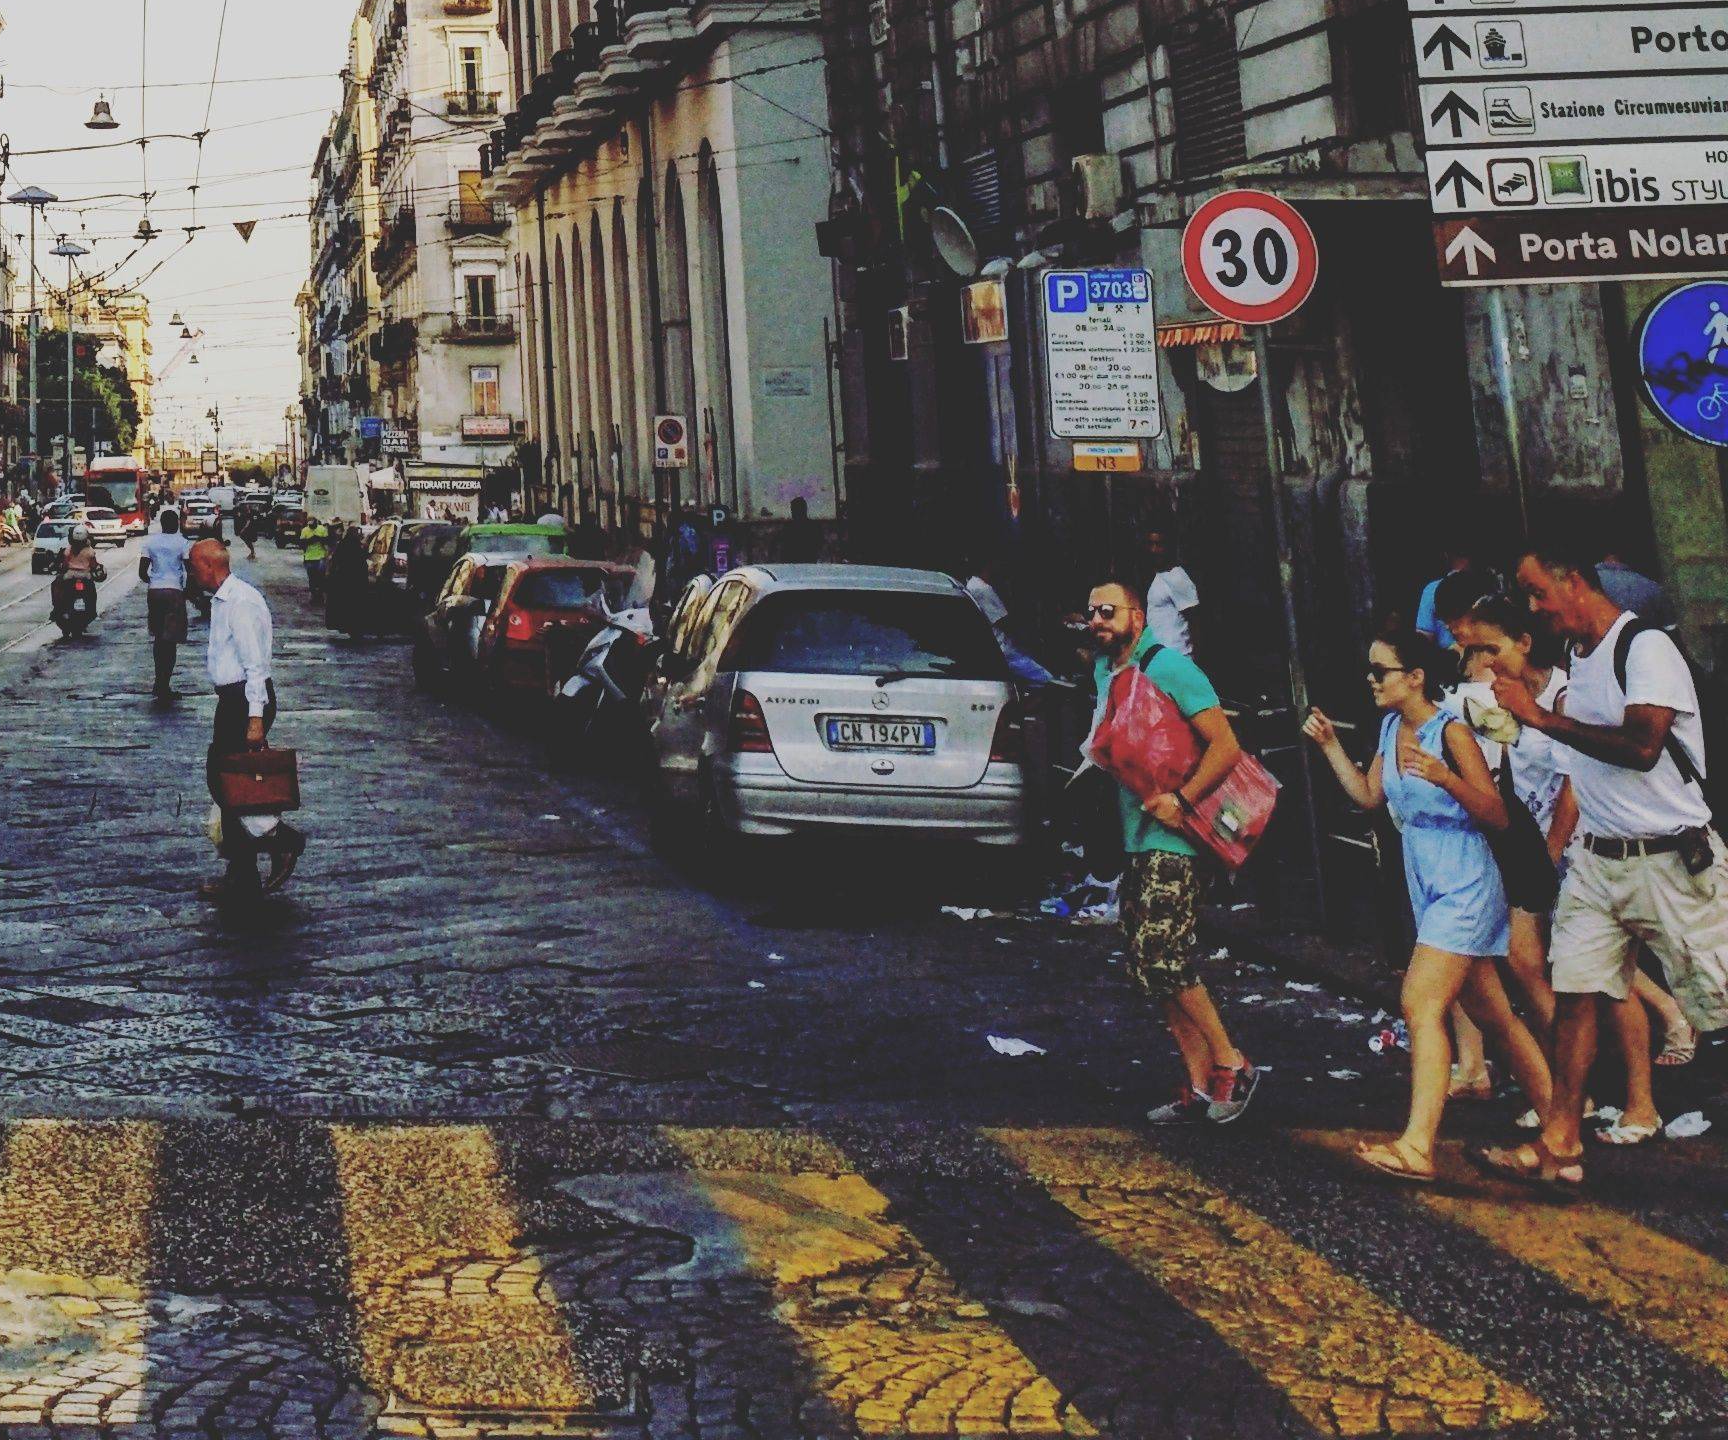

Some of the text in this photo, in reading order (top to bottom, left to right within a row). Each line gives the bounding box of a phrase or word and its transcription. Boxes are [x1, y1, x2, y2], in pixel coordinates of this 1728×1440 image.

[1631, 25, 1728, 54] Porto
[1540, 99, 1605, 118] Stazione
[1595, 168, 1660, 203] ibis
[1212, 227, 1288, 288] 30
[1520, 232, 1618, 262] Porta
[1057, 280, 1079, 308] P
[409, 480, 482, 490] RISTORANTE PIZZERIA
[713, 509, 726, 526] P
[841, 723, 922, 745] CN 194PV
